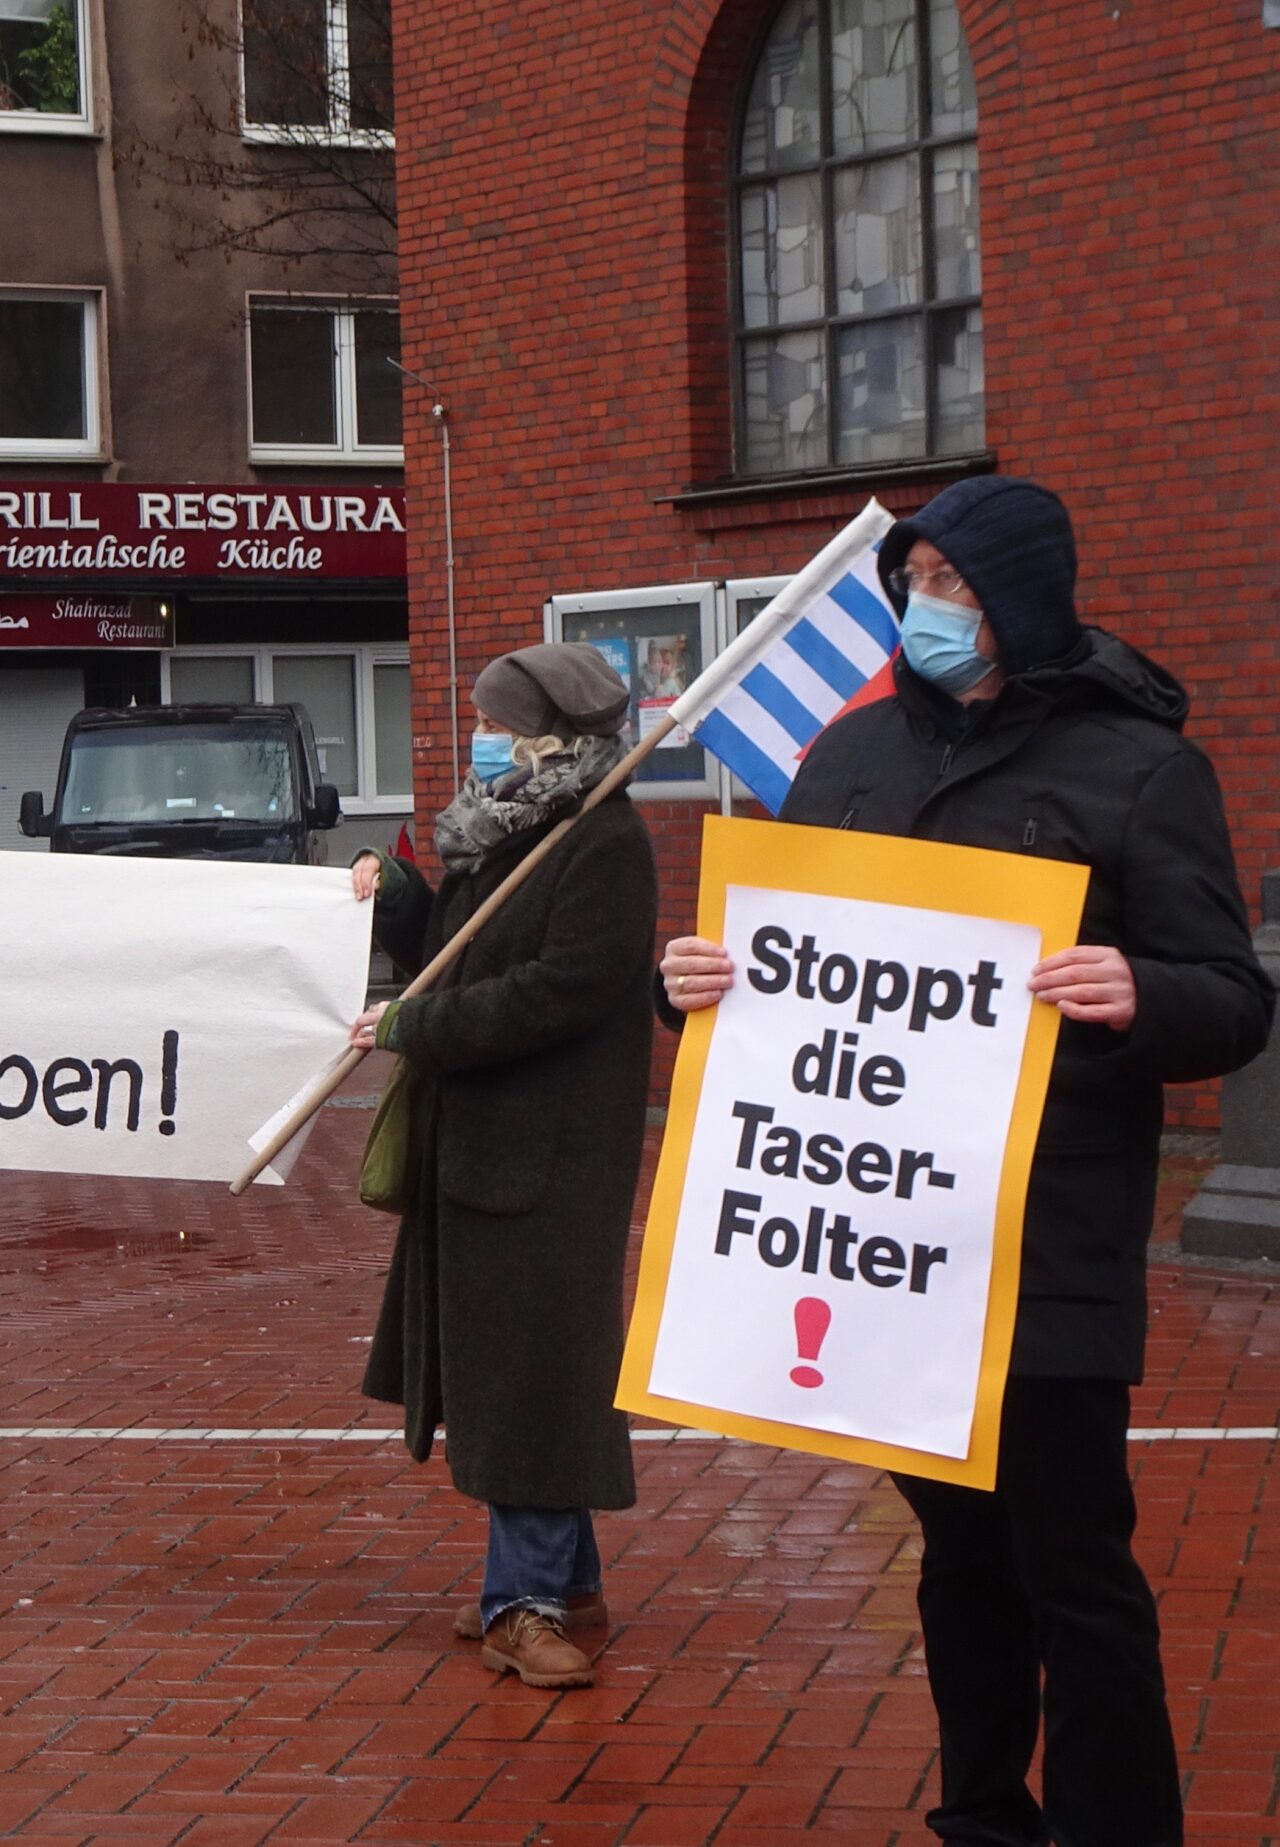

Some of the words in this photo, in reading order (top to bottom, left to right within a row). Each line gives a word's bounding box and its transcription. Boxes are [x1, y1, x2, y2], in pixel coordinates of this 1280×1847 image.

[138, 492, 407, 531] RESTAURA
[217, 536, 323, 570] Küche
[52, 597, 133, 619] Shahrazad
[97, 620, 165, 642] Restaurant
[747, 925, 1003, 1032] Stoppt
[791, 1029, 906, 1107] die
[732, 1100, 955, 1200] Taser-
[714, 1189, 948, 1293] Folter
[789, 1297, 832, 1388] !
